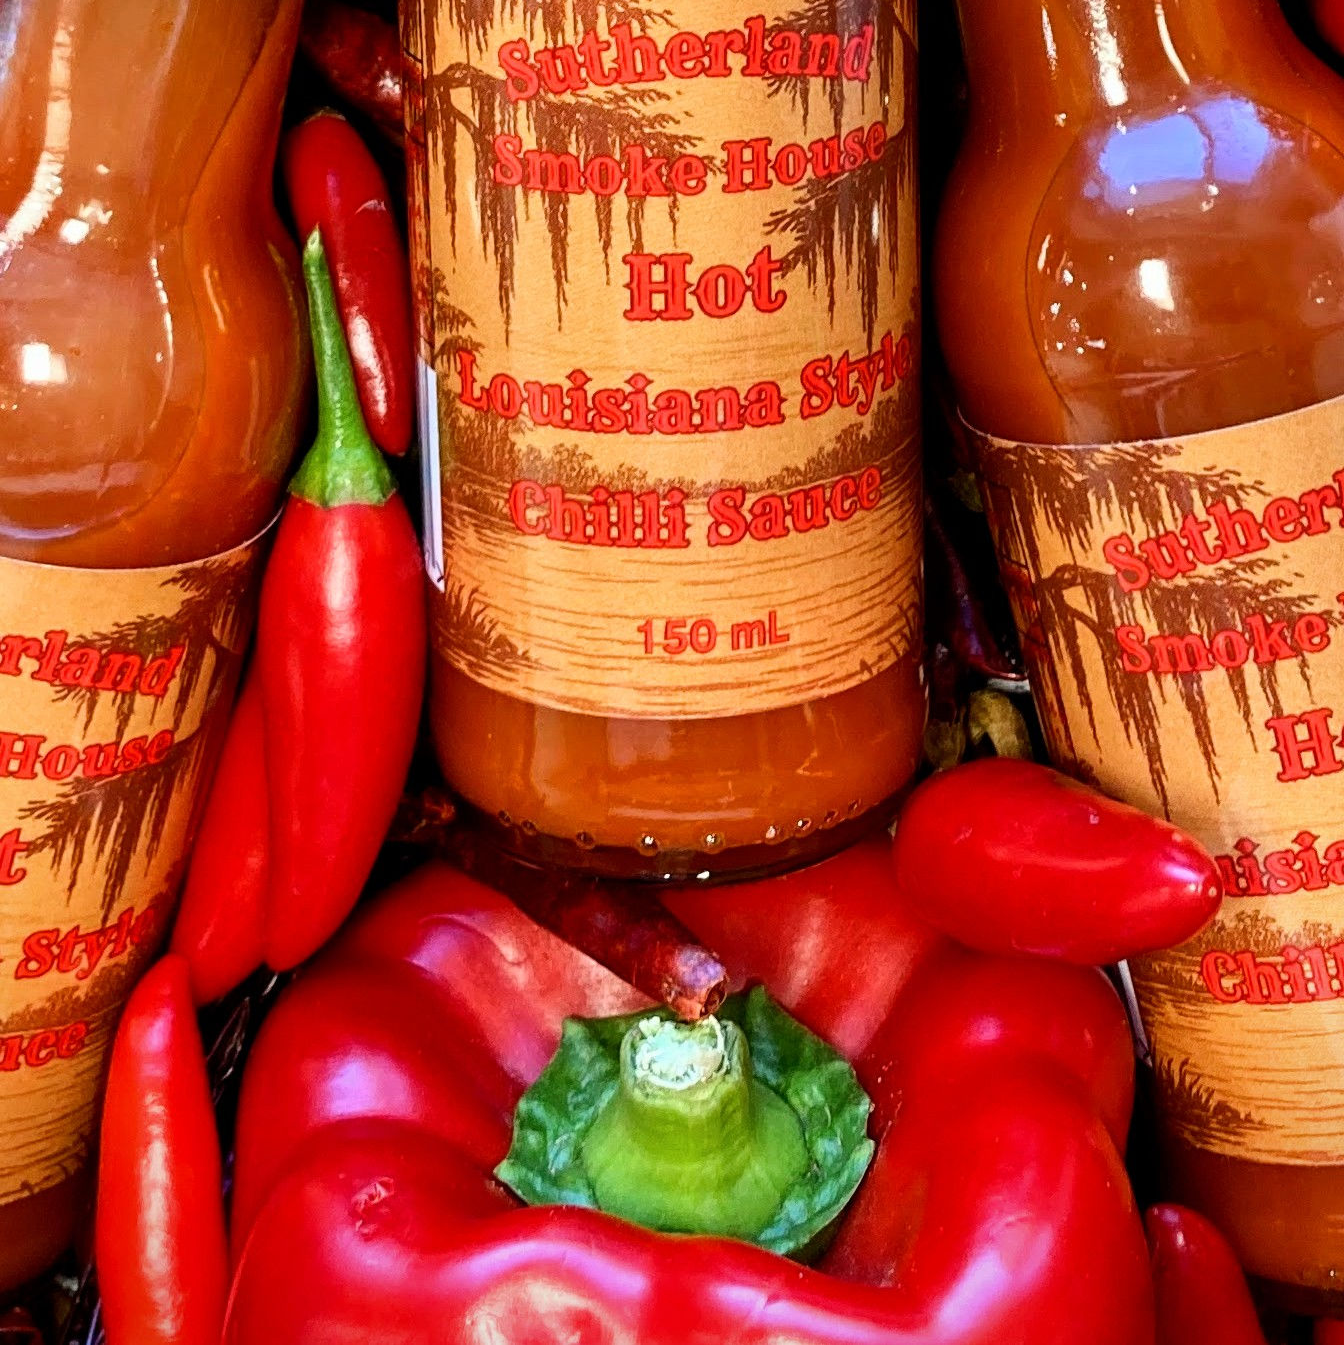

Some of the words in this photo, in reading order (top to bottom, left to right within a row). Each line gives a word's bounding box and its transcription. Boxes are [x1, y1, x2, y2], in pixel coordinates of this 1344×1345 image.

[498, 15, 875, 103] Sutherland
[493, 134, 707, 198] Smoke
[722, 115, 889, 194] House
[623, 244, 788, 324] Hot
[459, 347, 785, 436] Louisiana
[799, 331, 913, 419] Style
[509, 476, 692, 549] Chilli
[707, 465, 884, 548] Sauce
[638, 616, 718, 655] 150
[730, 610, 790, 653] mL
[1116, 604, 1331, 675] Smoke
